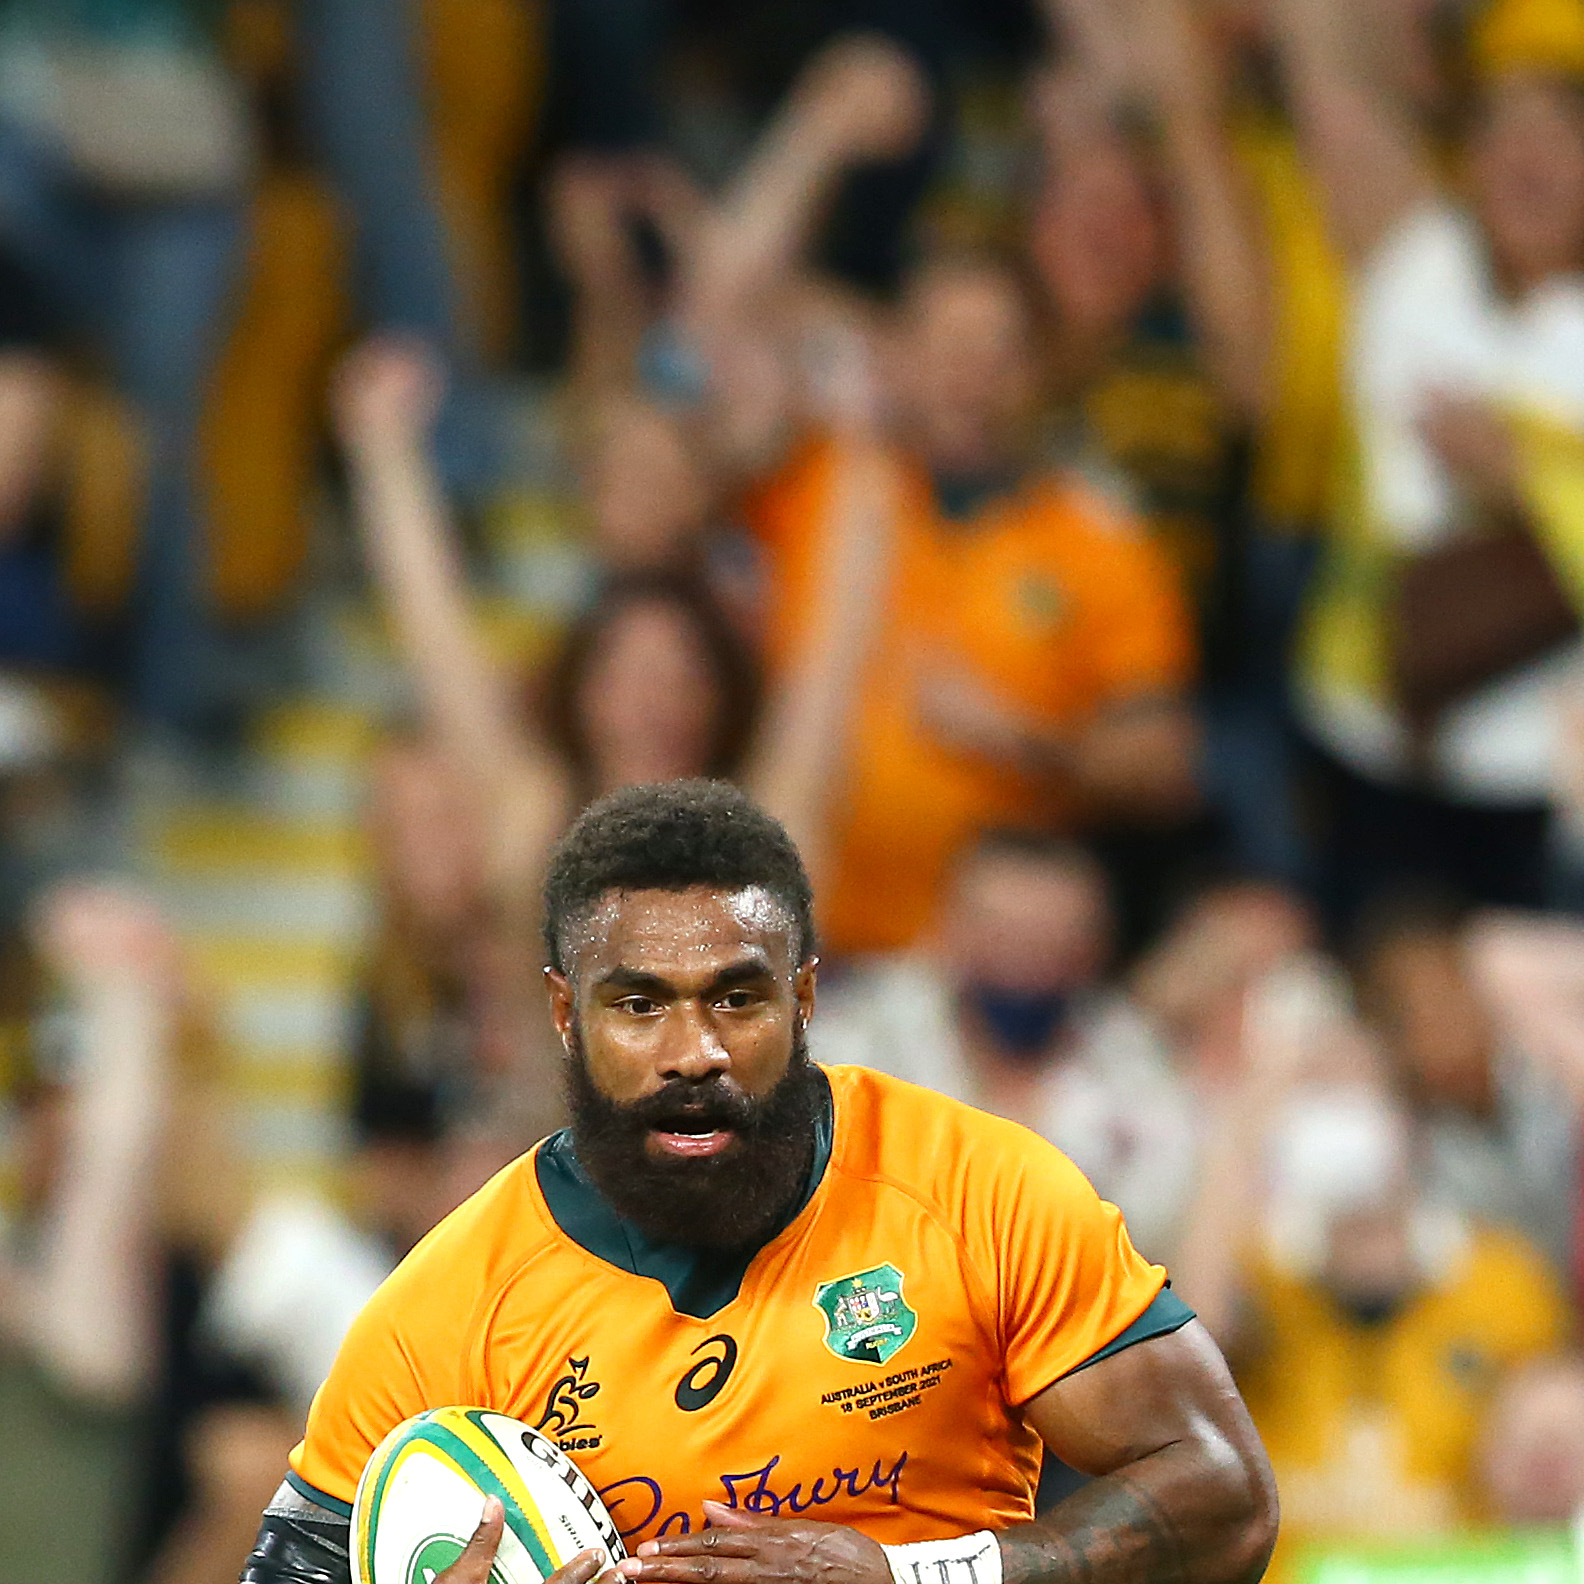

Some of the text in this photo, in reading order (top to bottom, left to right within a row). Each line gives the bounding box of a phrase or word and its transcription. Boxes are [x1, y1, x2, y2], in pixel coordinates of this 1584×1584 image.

[821, 1381, 877, 1404] AUSTRALIA
[885, 1369, 918, 1387] SOUTH
[920, 1358, 953, 1376] AFRICA
[856, 1385, 917, 1409] SEPTEMBER
[920, 1375, 941, 1390] 2021
[869, 1395, 922, 1420] BRISBANE
